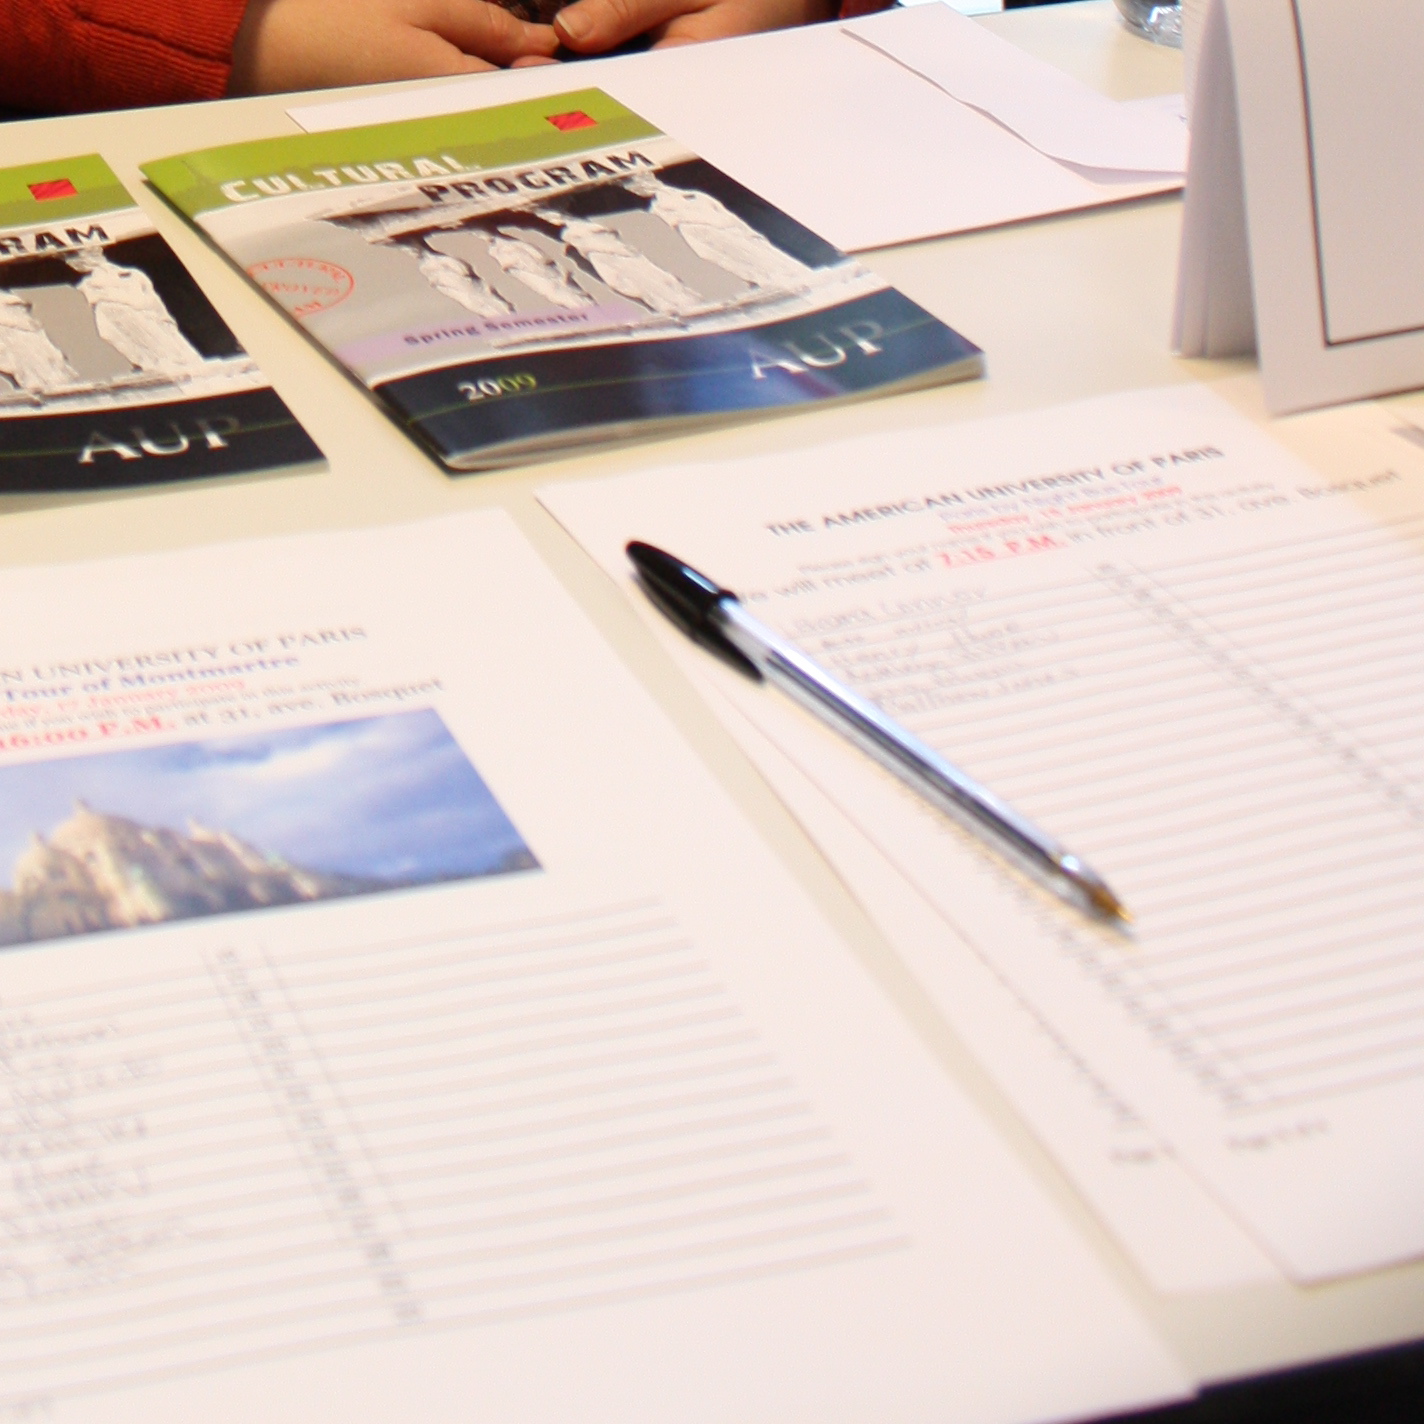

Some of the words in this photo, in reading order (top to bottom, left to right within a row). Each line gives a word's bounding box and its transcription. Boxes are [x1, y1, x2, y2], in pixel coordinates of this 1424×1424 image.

[219, 155, 481, 205] CULTURAL
[418, 150, 657, 205] PROGRAM
[402, 325, 479, 349] Spring
[484, 308, 590, 335] Semester
[749, 318, 885, 381] AUP
[457, 372, 537, 404] 2009
[77, 413, 242, 465] AUP
[821, 489, 966, 530] AMERICAN
[963, 464, 1107, 502] UNIVERSITY
[0, 680, 74, 702] Tour
[80, 675, 112, 692] of
[117, 652, 301, 688] Montmartre
[30, 642, 220, 682] UNIVERSITY
[226, 636, 270, 656] OF
[275, 624, 369, 651] PARIS
[328, 675, 445, 705] Bosquet
